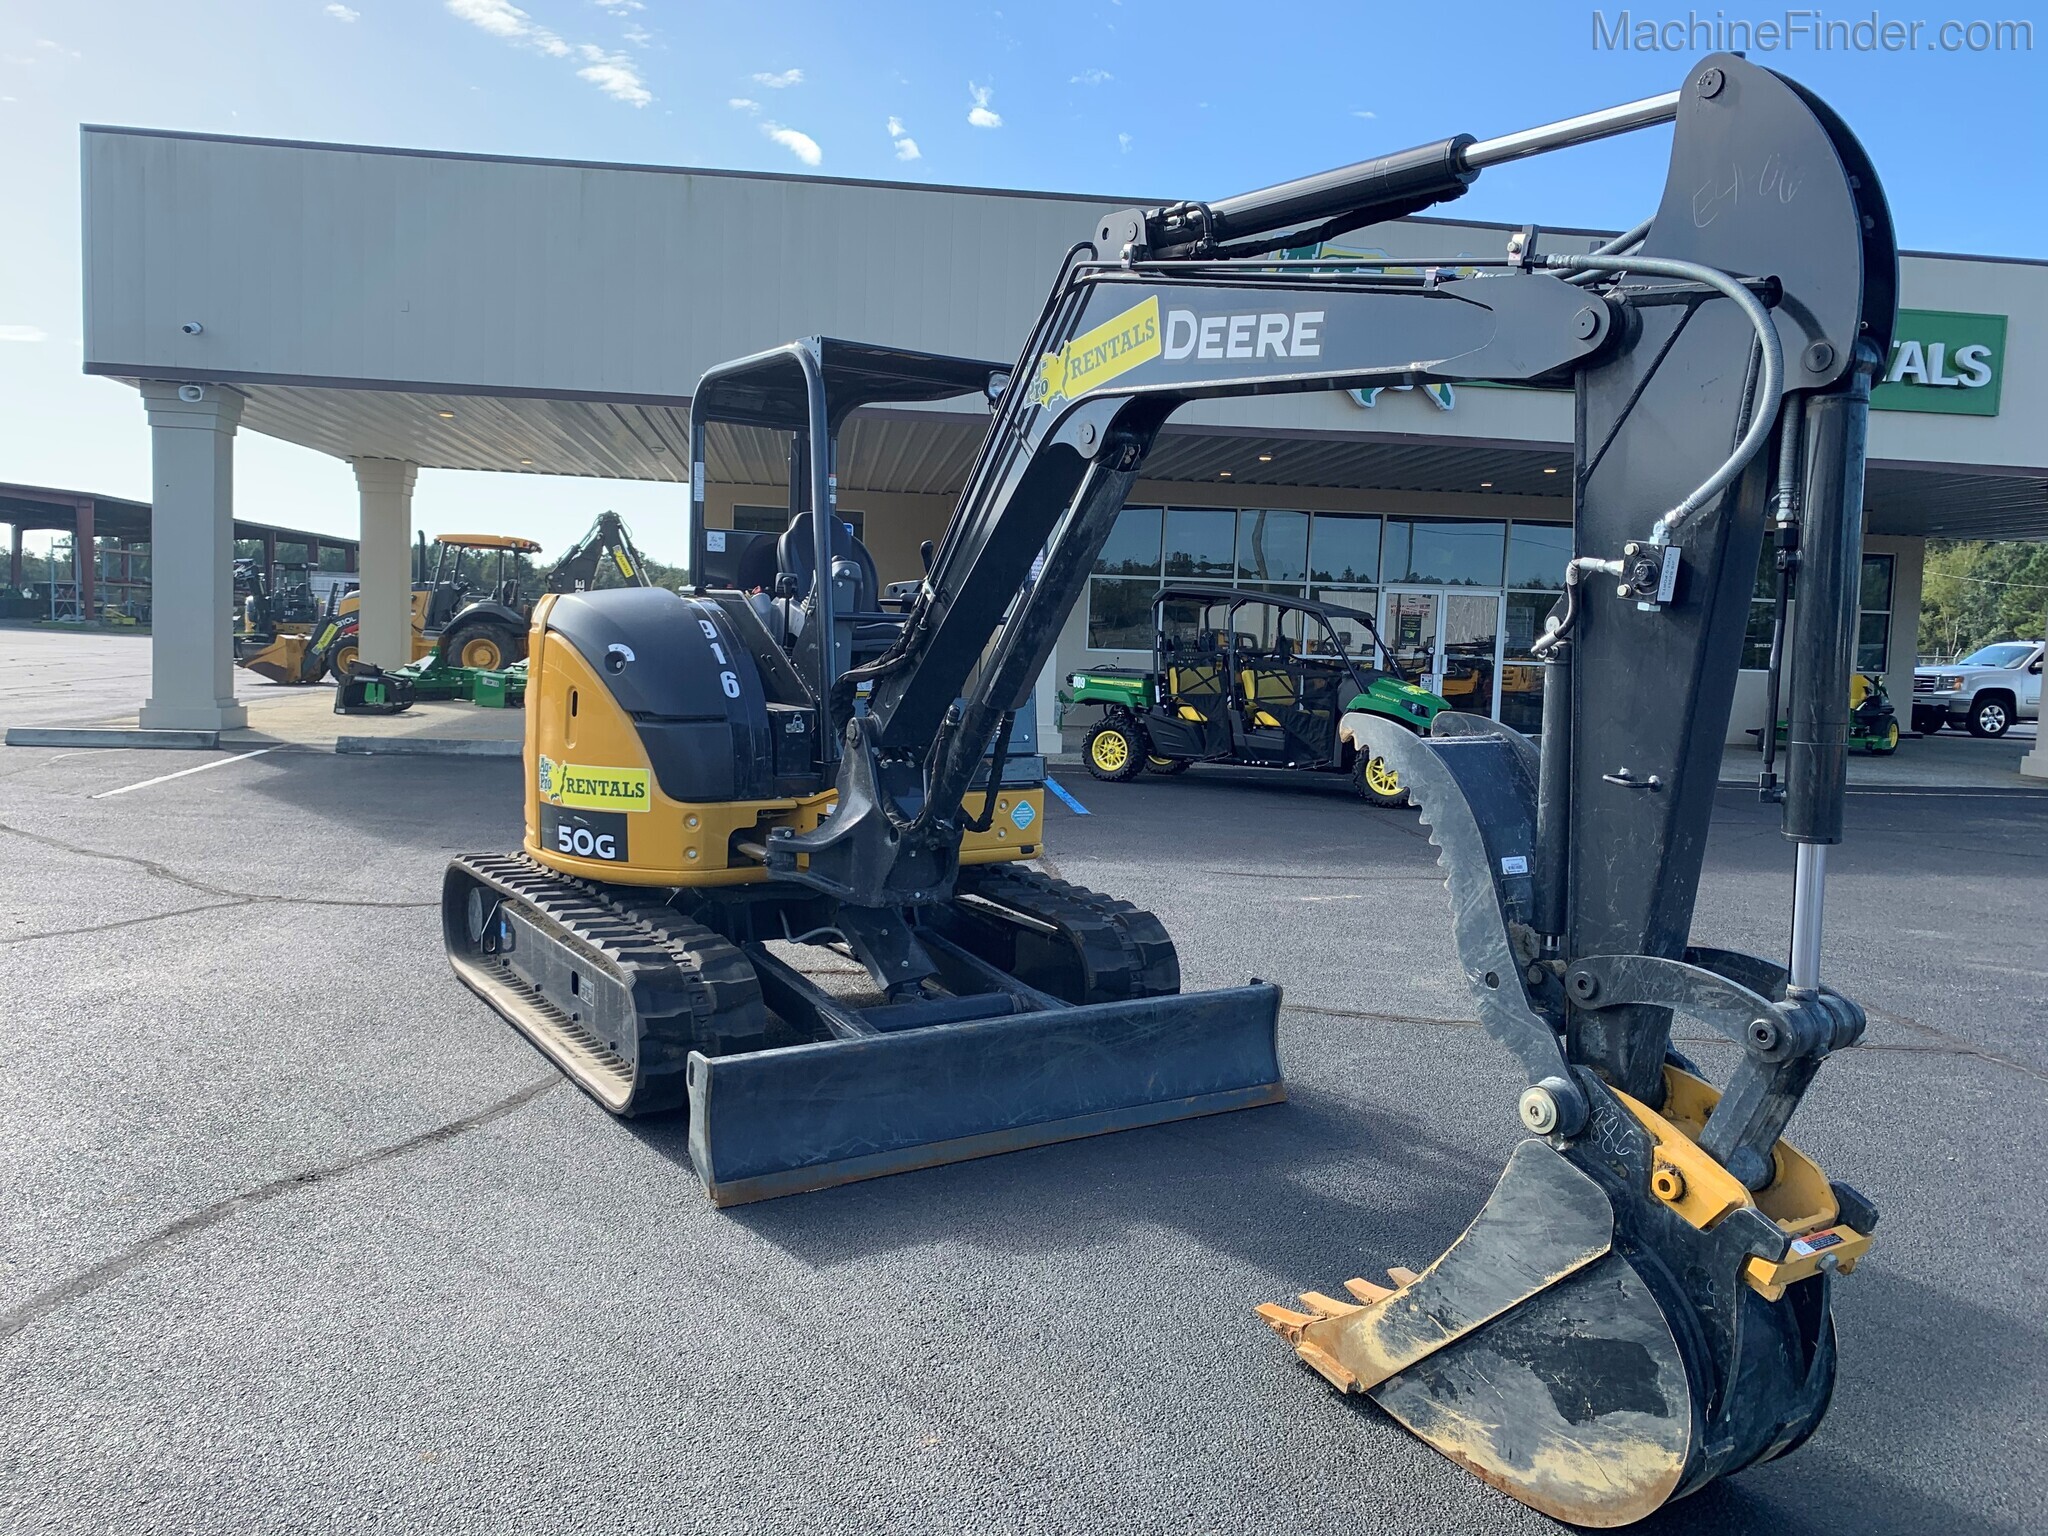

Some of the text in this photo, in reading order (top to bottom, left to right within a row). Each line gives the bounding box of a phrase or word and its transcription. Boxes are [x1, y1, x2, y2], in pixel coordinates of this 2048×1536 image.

[1070, 315, 1156, 380] RENTALS
[1163, 309, 1325, 360] DEERE
[1882, 340, 1993, 388] ALS
[336, 617, 357, 628] 310L
[698, 619, 741, 699] 916
[565, 777, 646, 798] RENTALS
[558, 824, 616, 860] 50G
